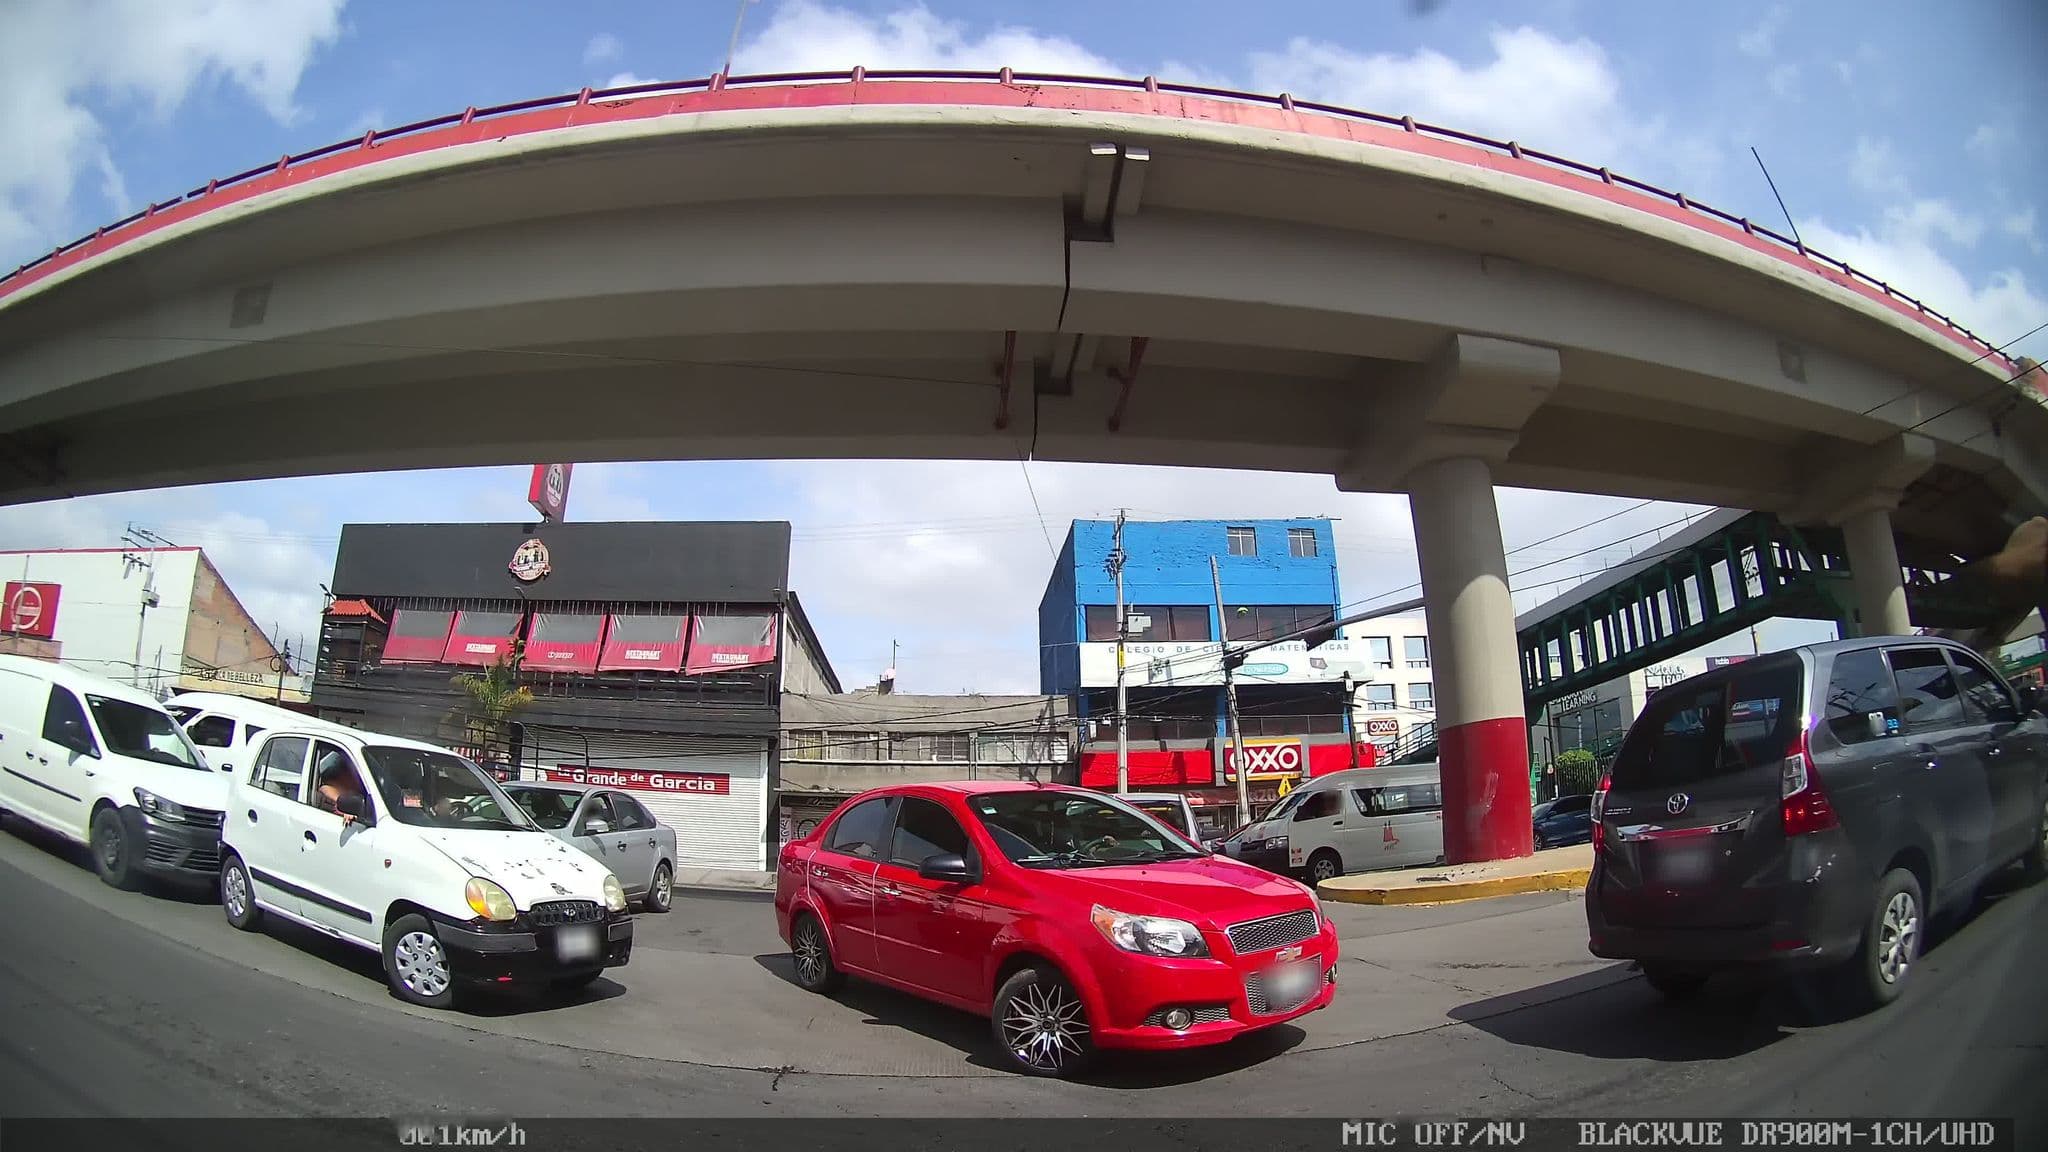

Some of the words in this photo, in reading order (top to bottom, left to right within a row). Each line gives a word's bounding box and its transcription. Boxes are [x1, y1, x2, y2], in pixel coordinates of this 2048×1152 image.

[1108, 645, 1165, 654] CLEGIO
[1176, 645, 1192, 654] DE
[1370, 719, 1397, 732] OXXO
[1229, 743, 1299, 774] OXXO
[572, 769, 627, 787] Grande
[630, 772, 645, 783] de
[649, 774, 716, 791] Garcia
